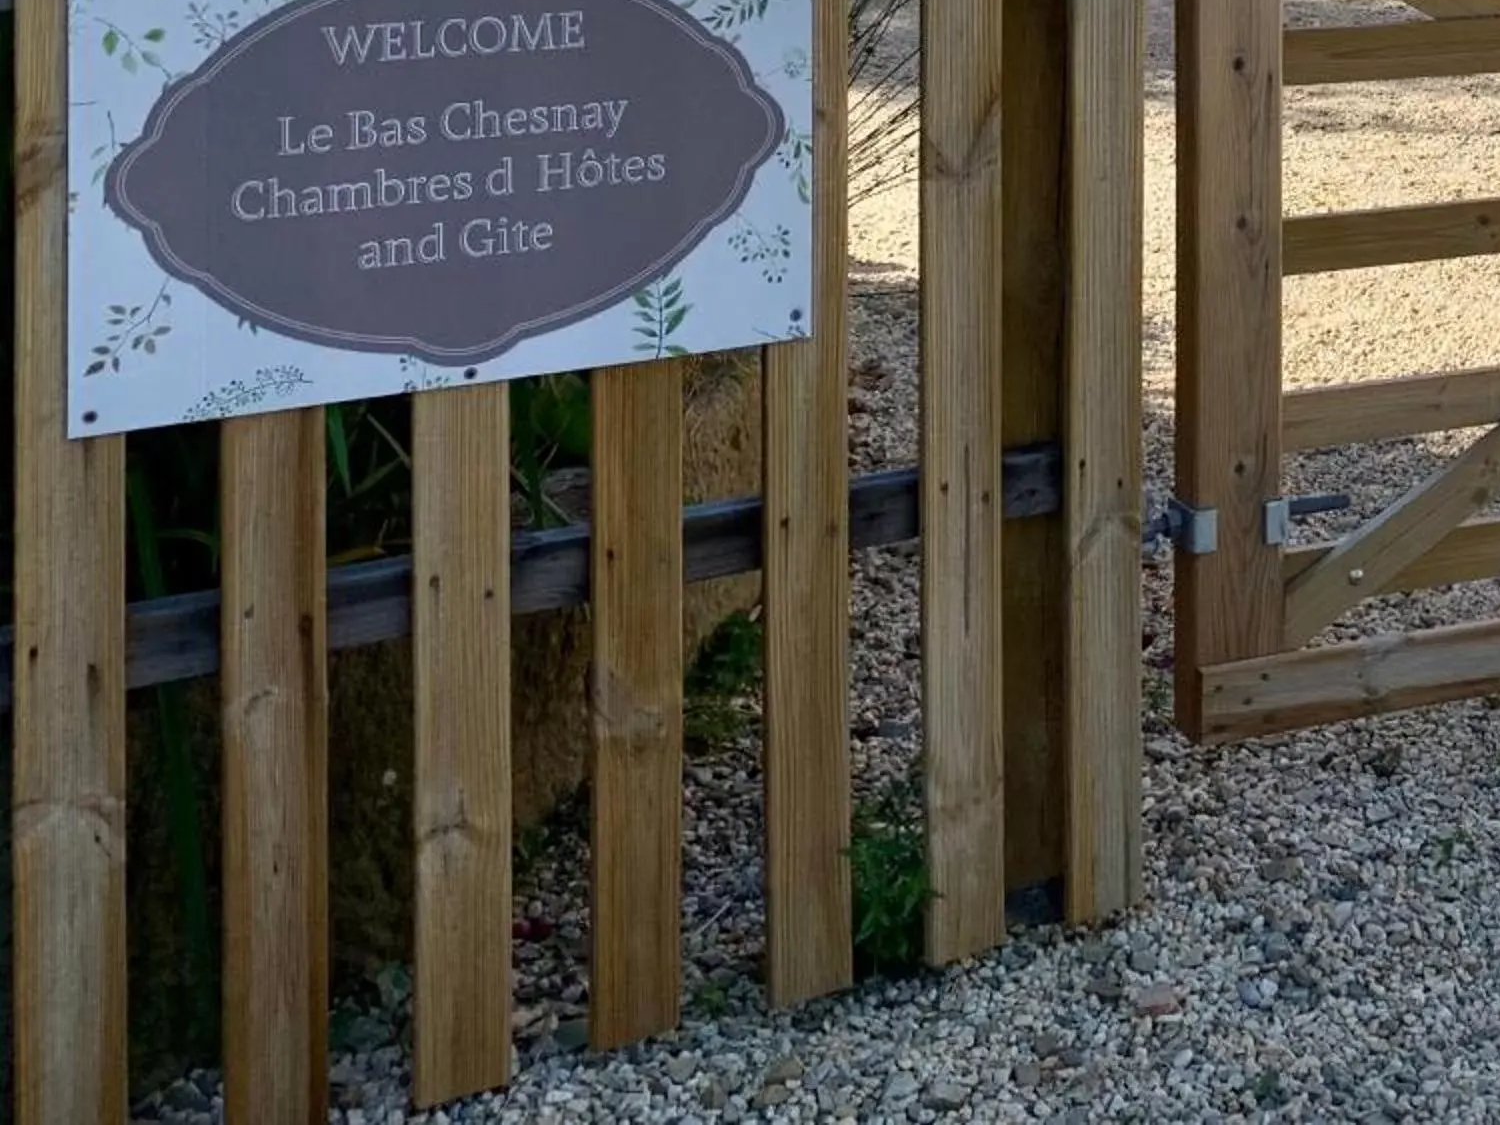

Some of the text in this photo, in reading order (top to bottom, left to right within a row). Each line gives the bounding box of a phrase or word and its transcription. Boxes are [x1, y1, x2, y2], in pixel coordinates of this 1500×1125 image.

[322, 11, 585, 66] WELCOME
[278, 98, 628, 156] Le Bas Chesnay
[232, 148, 667, 221] Chambres d Hôtes
[358, 217, 554, 270] and Gite
